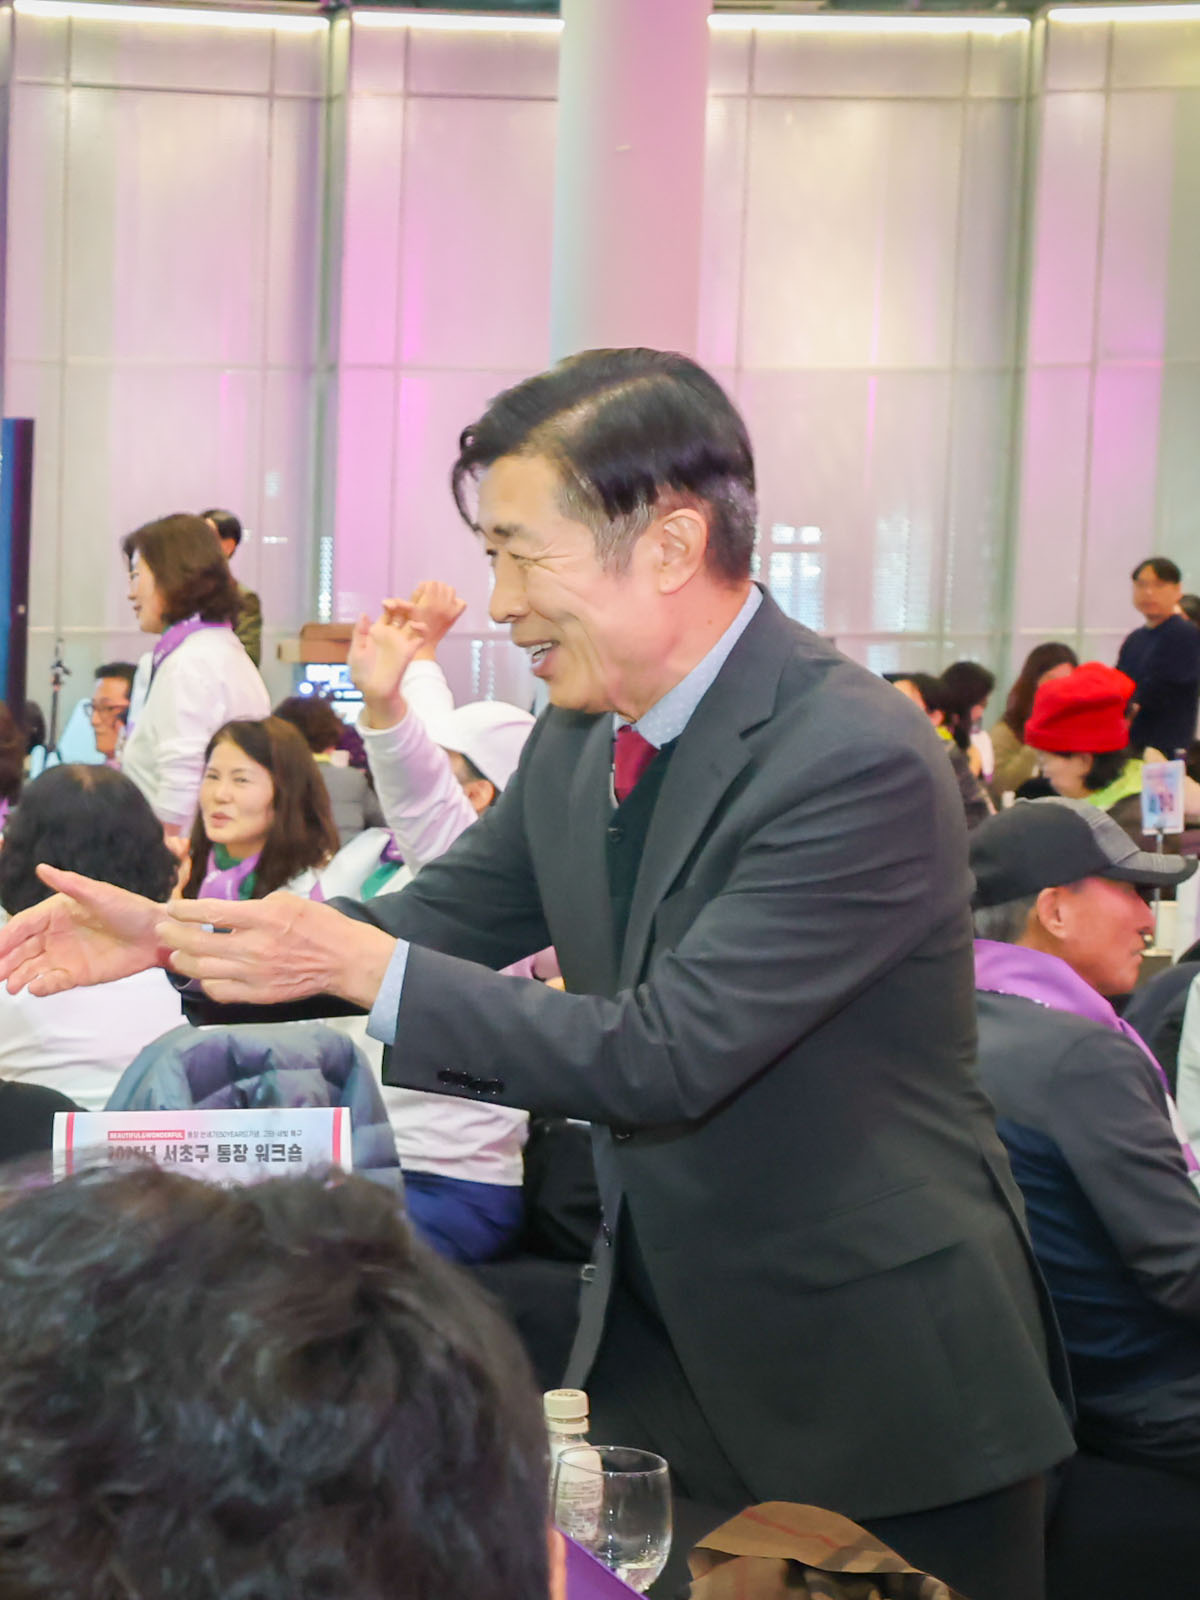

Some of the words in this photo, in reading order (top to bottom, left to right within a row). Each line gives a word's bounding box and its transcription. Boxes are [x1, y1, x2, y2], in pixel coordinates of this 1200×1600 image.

[163, 1144, 210, 1163] 서초구
[216, 1144, 248, 1163] 통장
[255, 1144, 303, 1163] 워크숍
